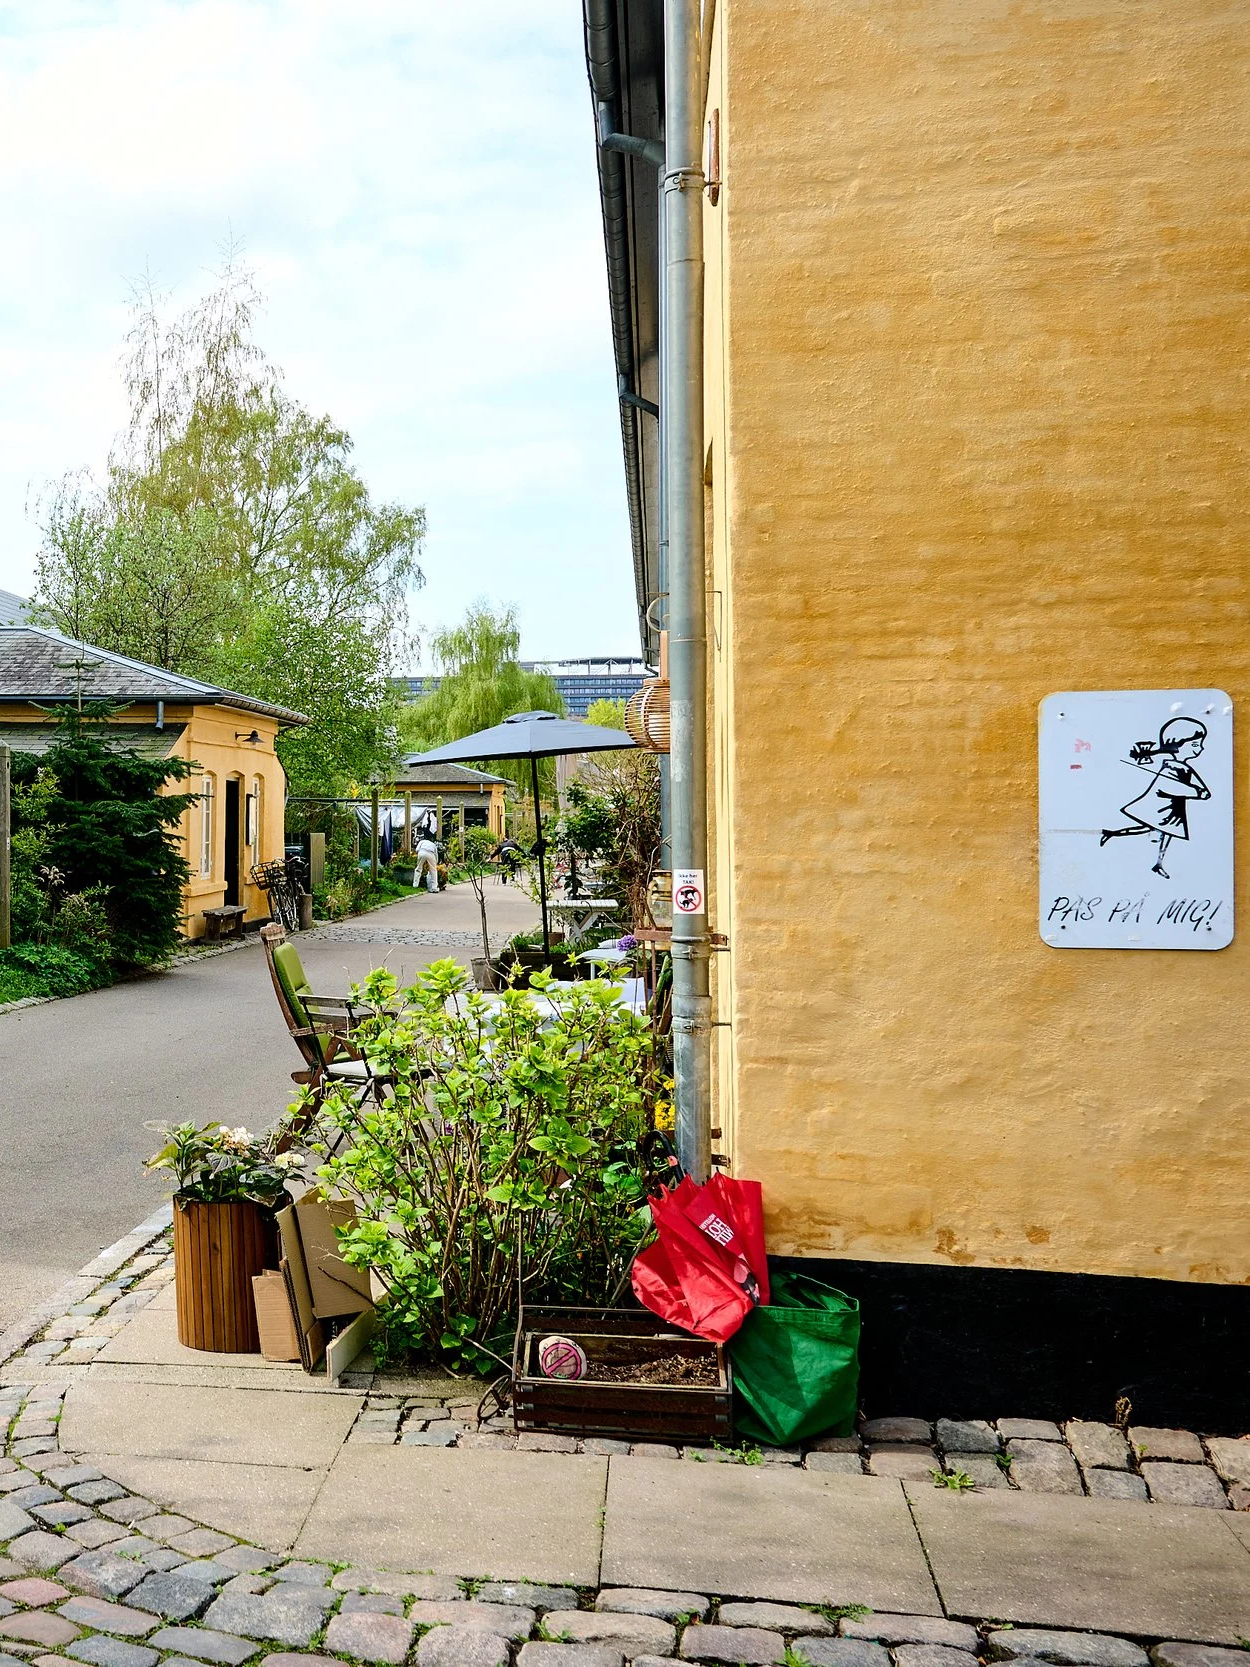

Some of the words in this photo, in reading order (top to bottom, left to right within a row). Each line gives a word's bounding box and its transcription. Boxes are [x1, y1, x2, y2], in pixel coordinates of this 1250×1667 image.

[1047, 896, 1102, 922] PAS
[1108, 892, 1149, 923] PÅ
[1156, 899, 1222, 931] MIG!
